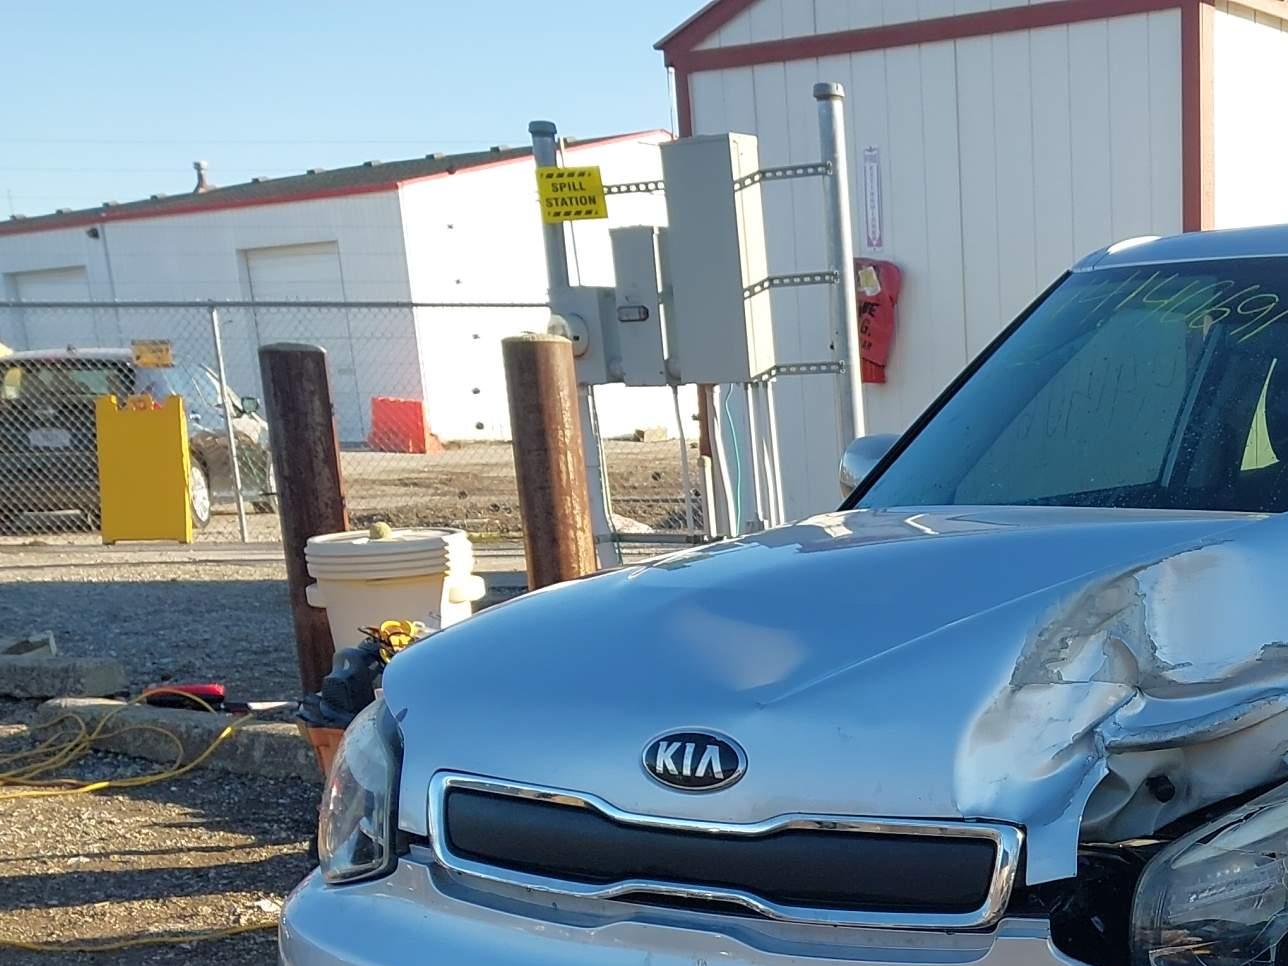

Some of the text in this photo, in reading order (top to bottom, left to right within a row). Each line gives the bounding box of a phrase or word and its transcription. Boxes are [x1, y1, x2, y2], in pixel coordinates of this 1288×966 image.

[551, 181, 587, 193] SPILL
[545, 195, 597, 208] STATION
[655, 740, 725, 780] KIA
